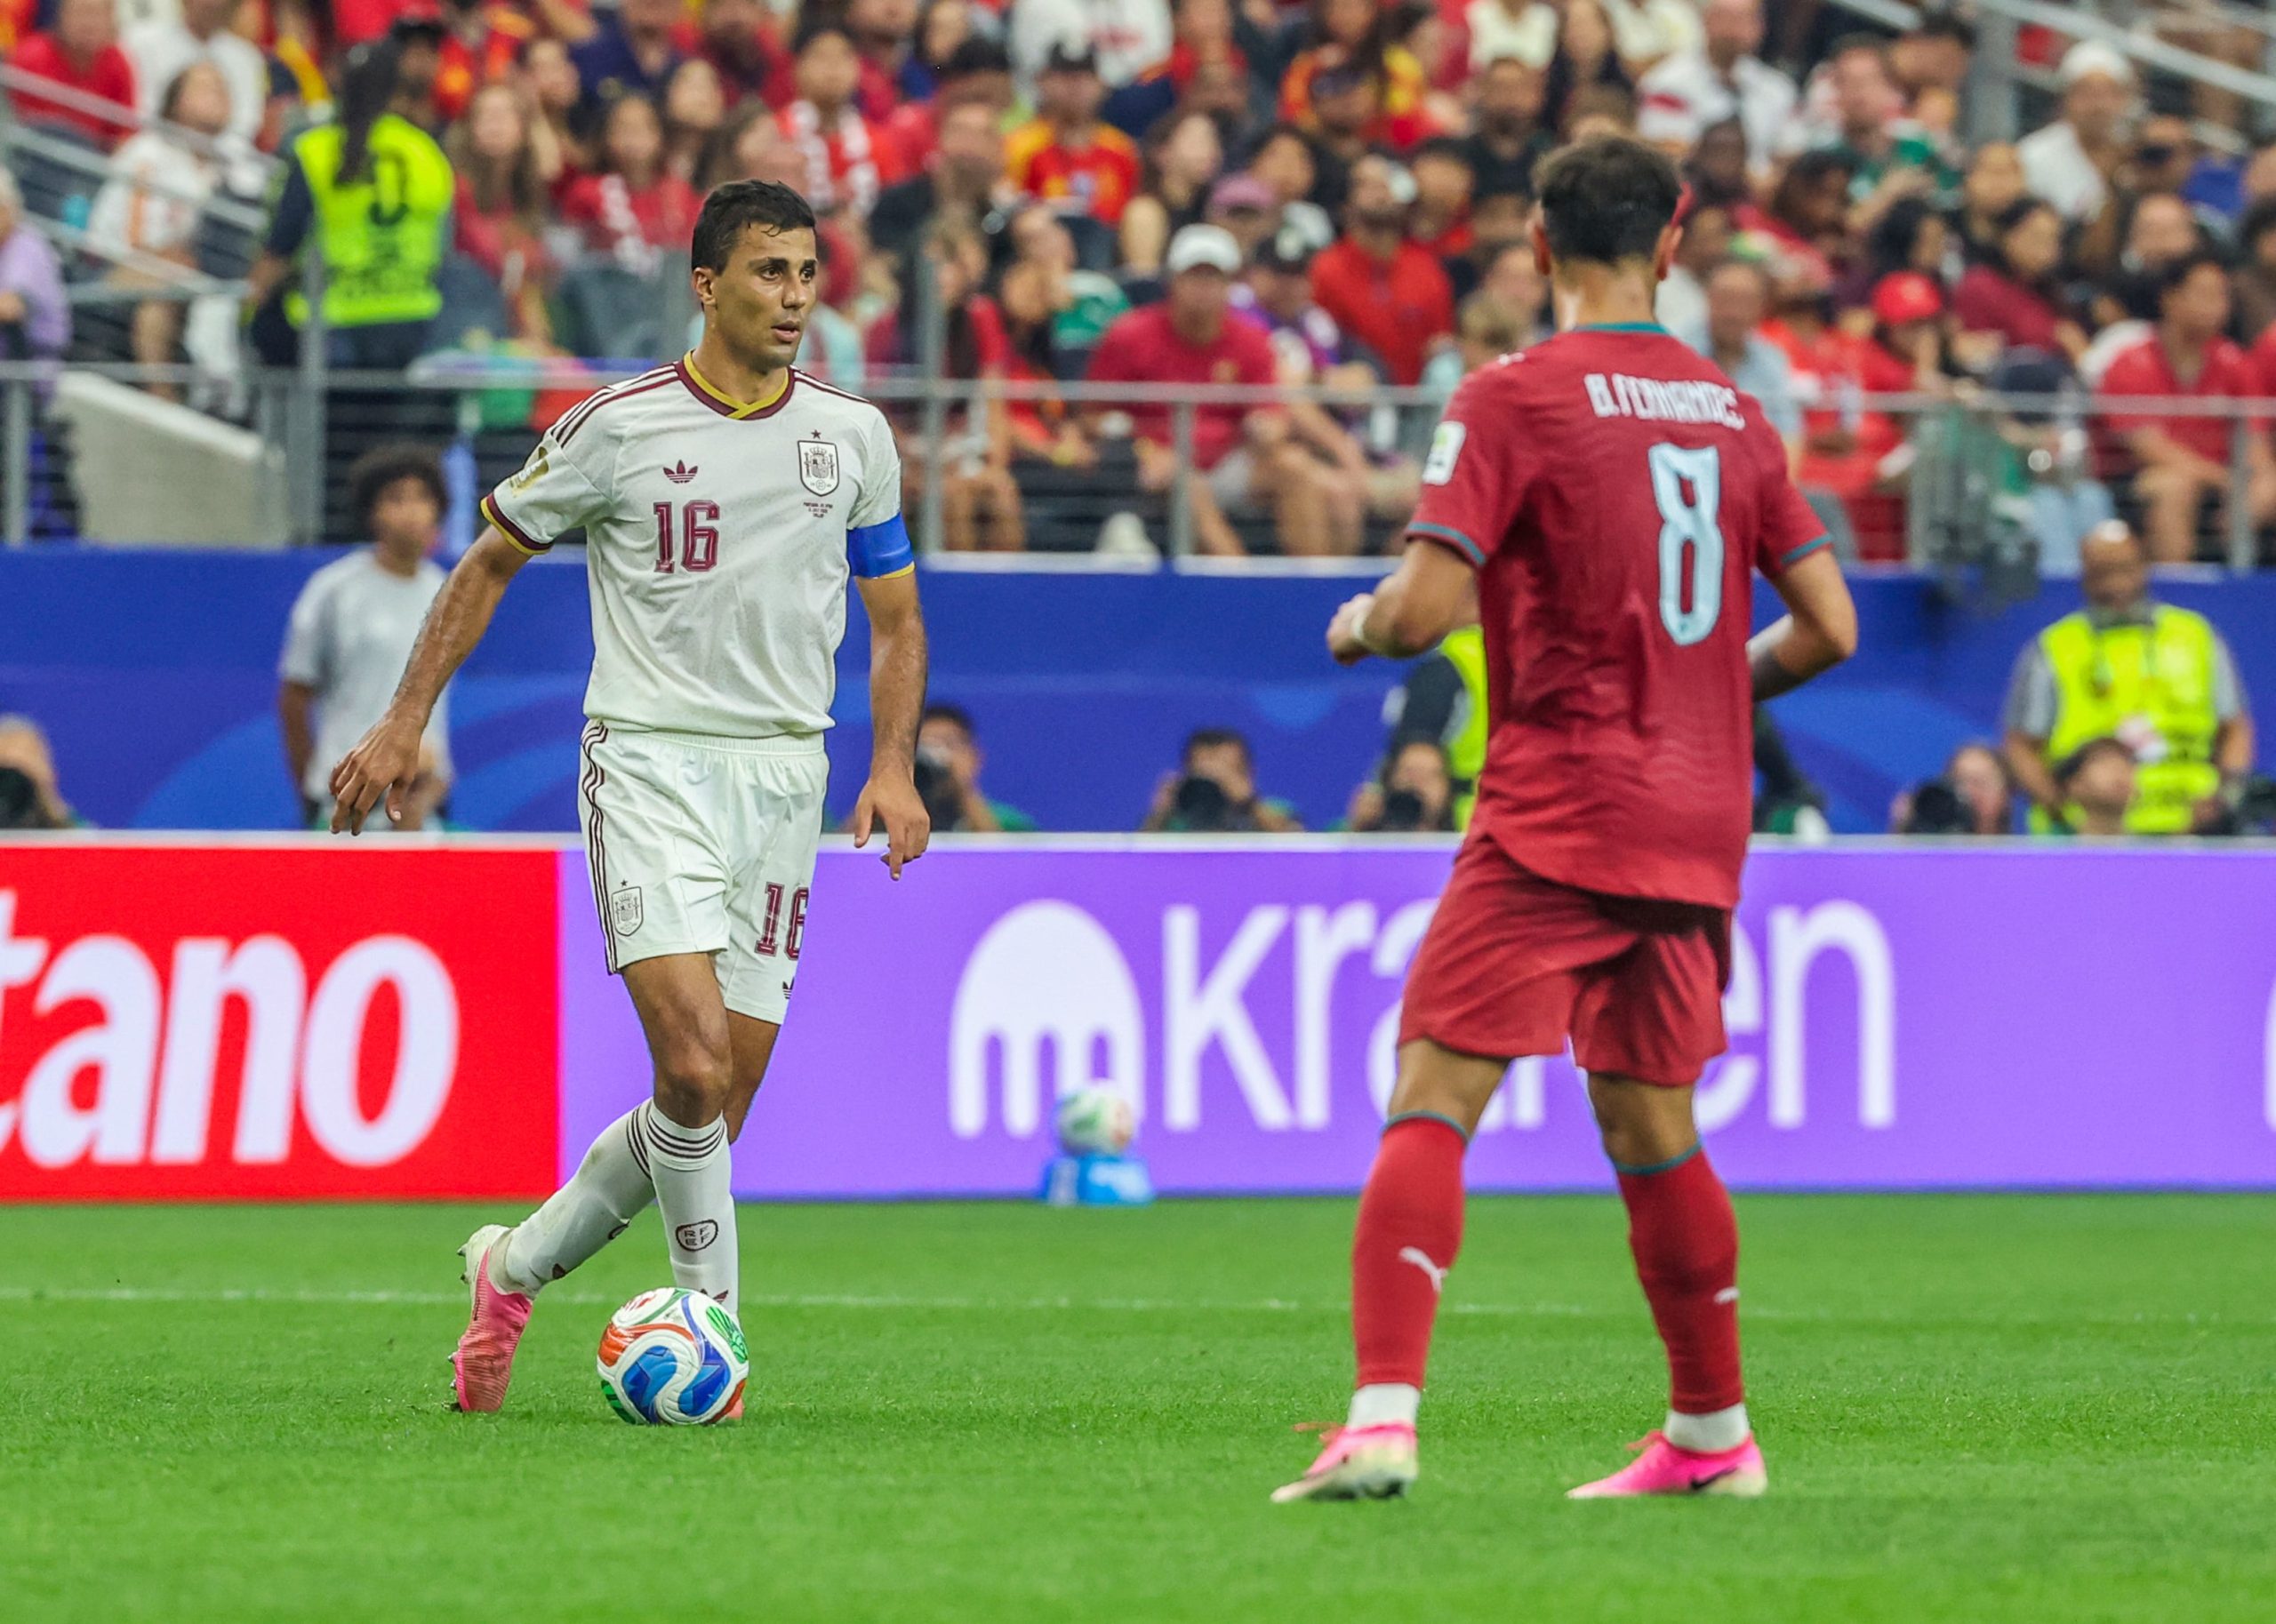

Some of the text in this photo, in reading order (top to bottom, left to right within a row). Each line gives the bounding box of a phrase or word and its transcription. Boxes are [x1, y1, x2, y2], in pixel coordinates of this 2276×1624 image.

[653, 500, 720, 574] 16
[1647, 441, 1725, 646] 8
[0, 888, 461, 1170] ano
